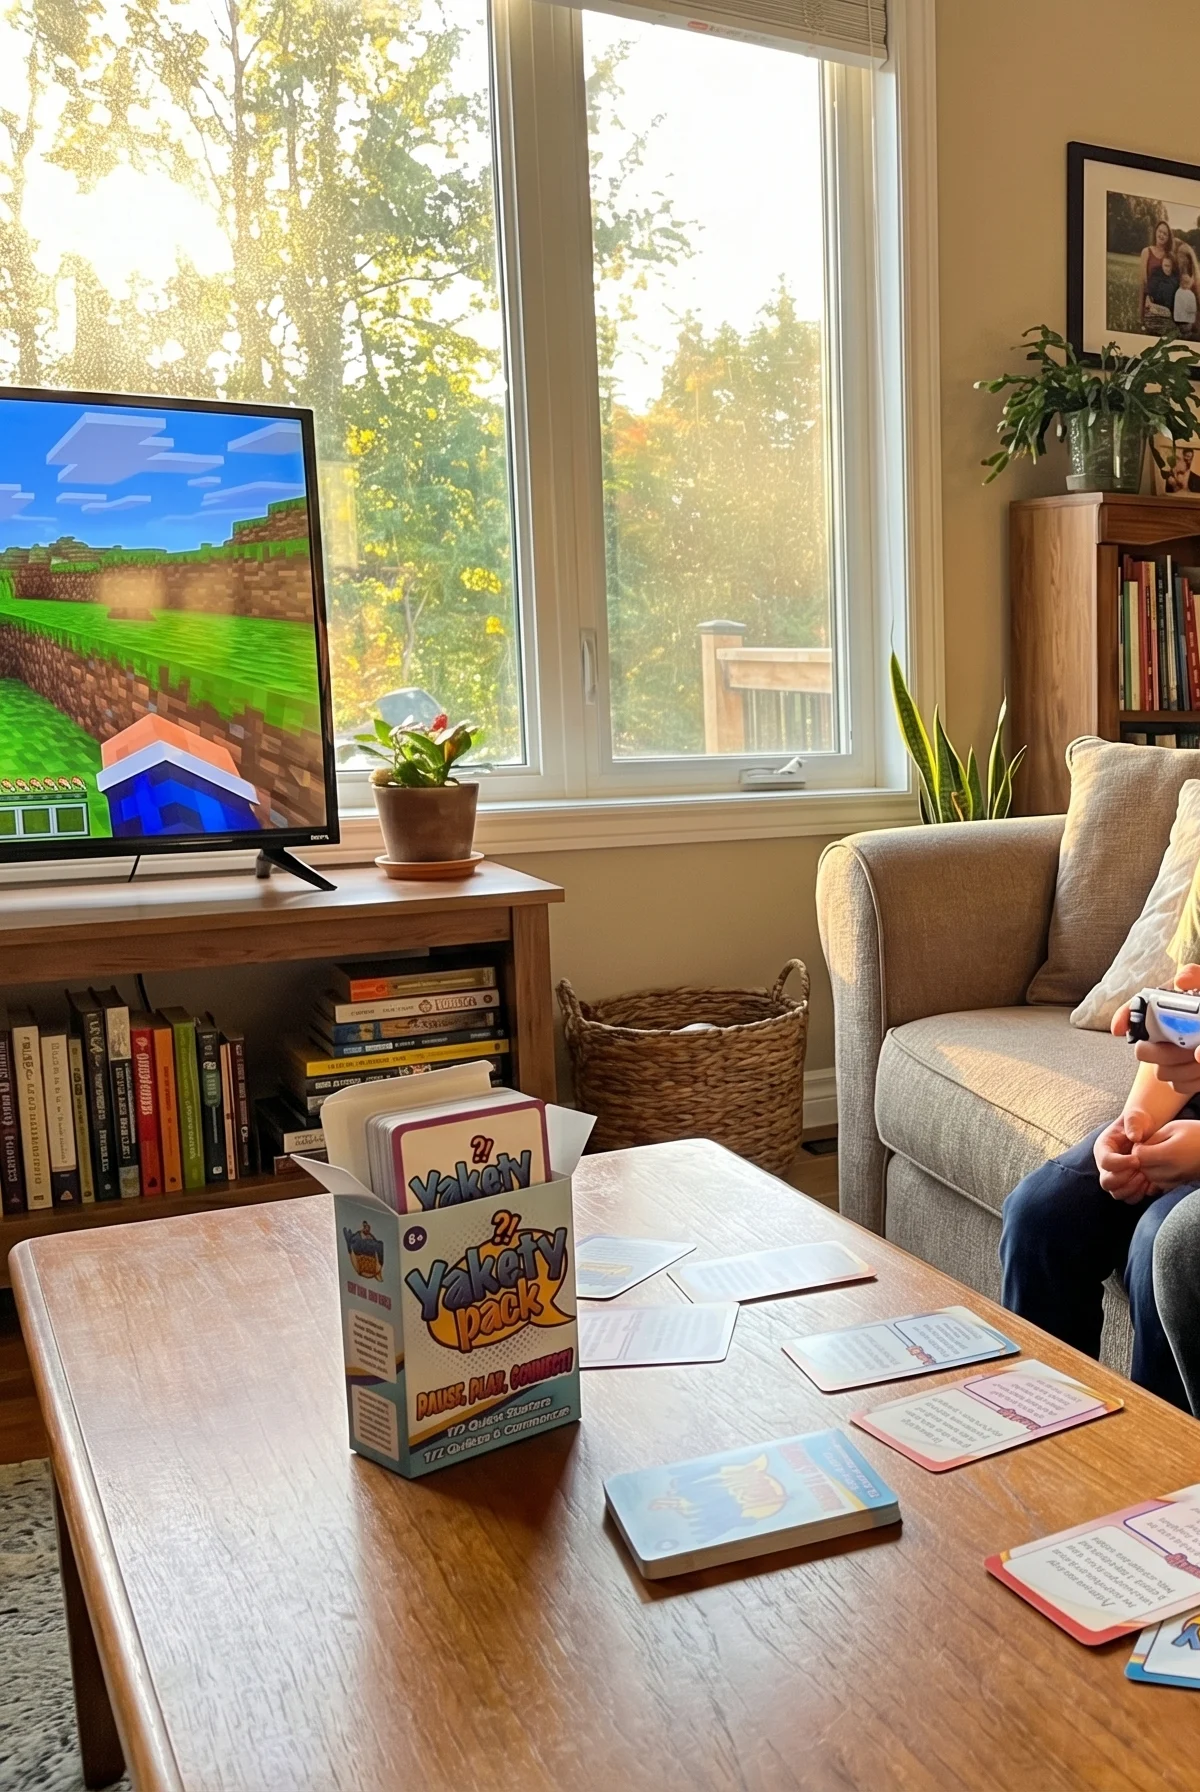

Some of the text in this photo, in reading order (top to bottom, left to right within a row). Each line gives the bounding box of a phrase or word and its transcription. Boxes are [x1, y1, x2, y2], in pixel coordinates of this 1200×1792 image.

[470, 1135, 494, 1164] ?!
[408, 1150, 532, 1212] Yakety
[491, 1209, 521, 1246] ?!
[404, 1227, 568, 1322] Yakety
[455, 1277, 545, 1354] pack
